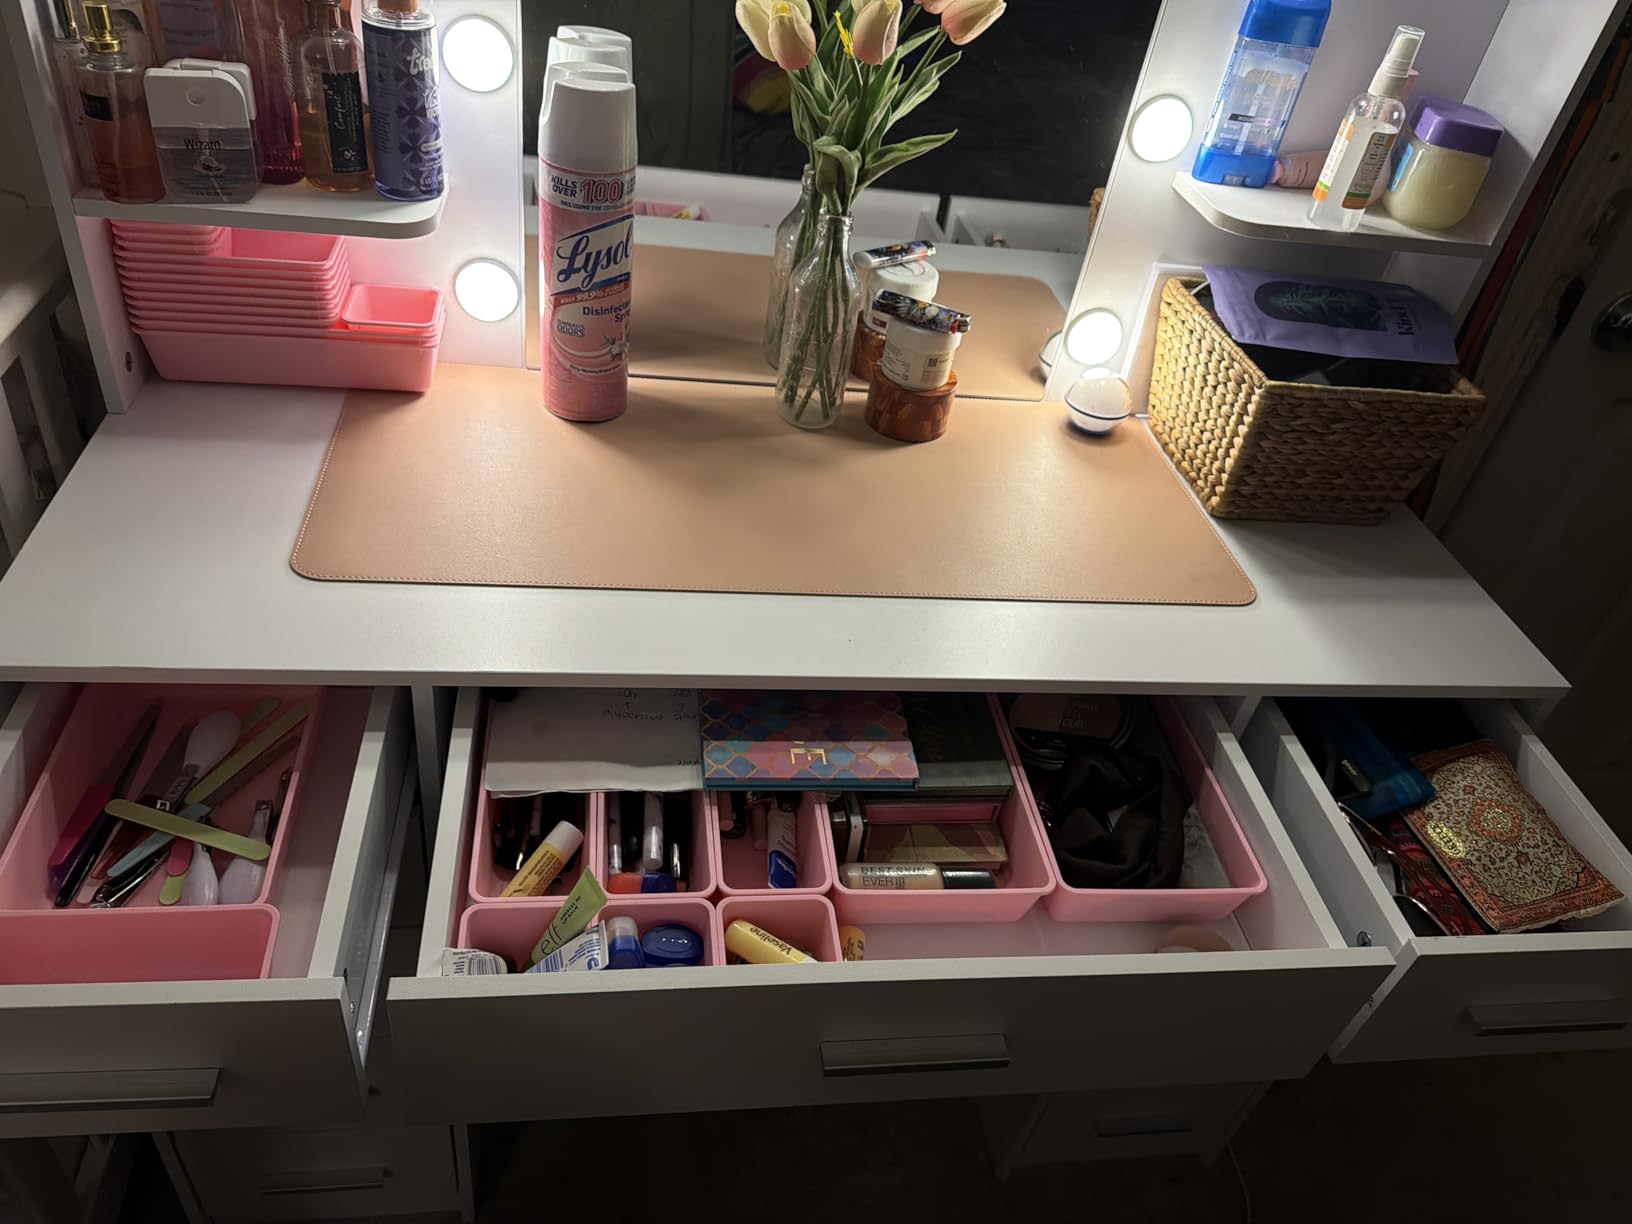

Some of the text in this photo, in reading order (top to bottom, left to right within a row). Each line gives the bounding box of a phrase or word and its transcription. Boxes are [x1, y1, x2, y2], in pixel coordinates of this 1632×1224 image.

[551, 174, 578, 189] KILLS
[552, 184, 578, 199] OVER
[580, 178, 624, 204] 100
[556, 224, 633, 289] Lysol
[557, 324, 585, 337] ODORS
[861, 866, 926, 875] BEST SKIN
[862, 876, 894, 887] EVER
[749, 926, 793, 956] Vaseline
